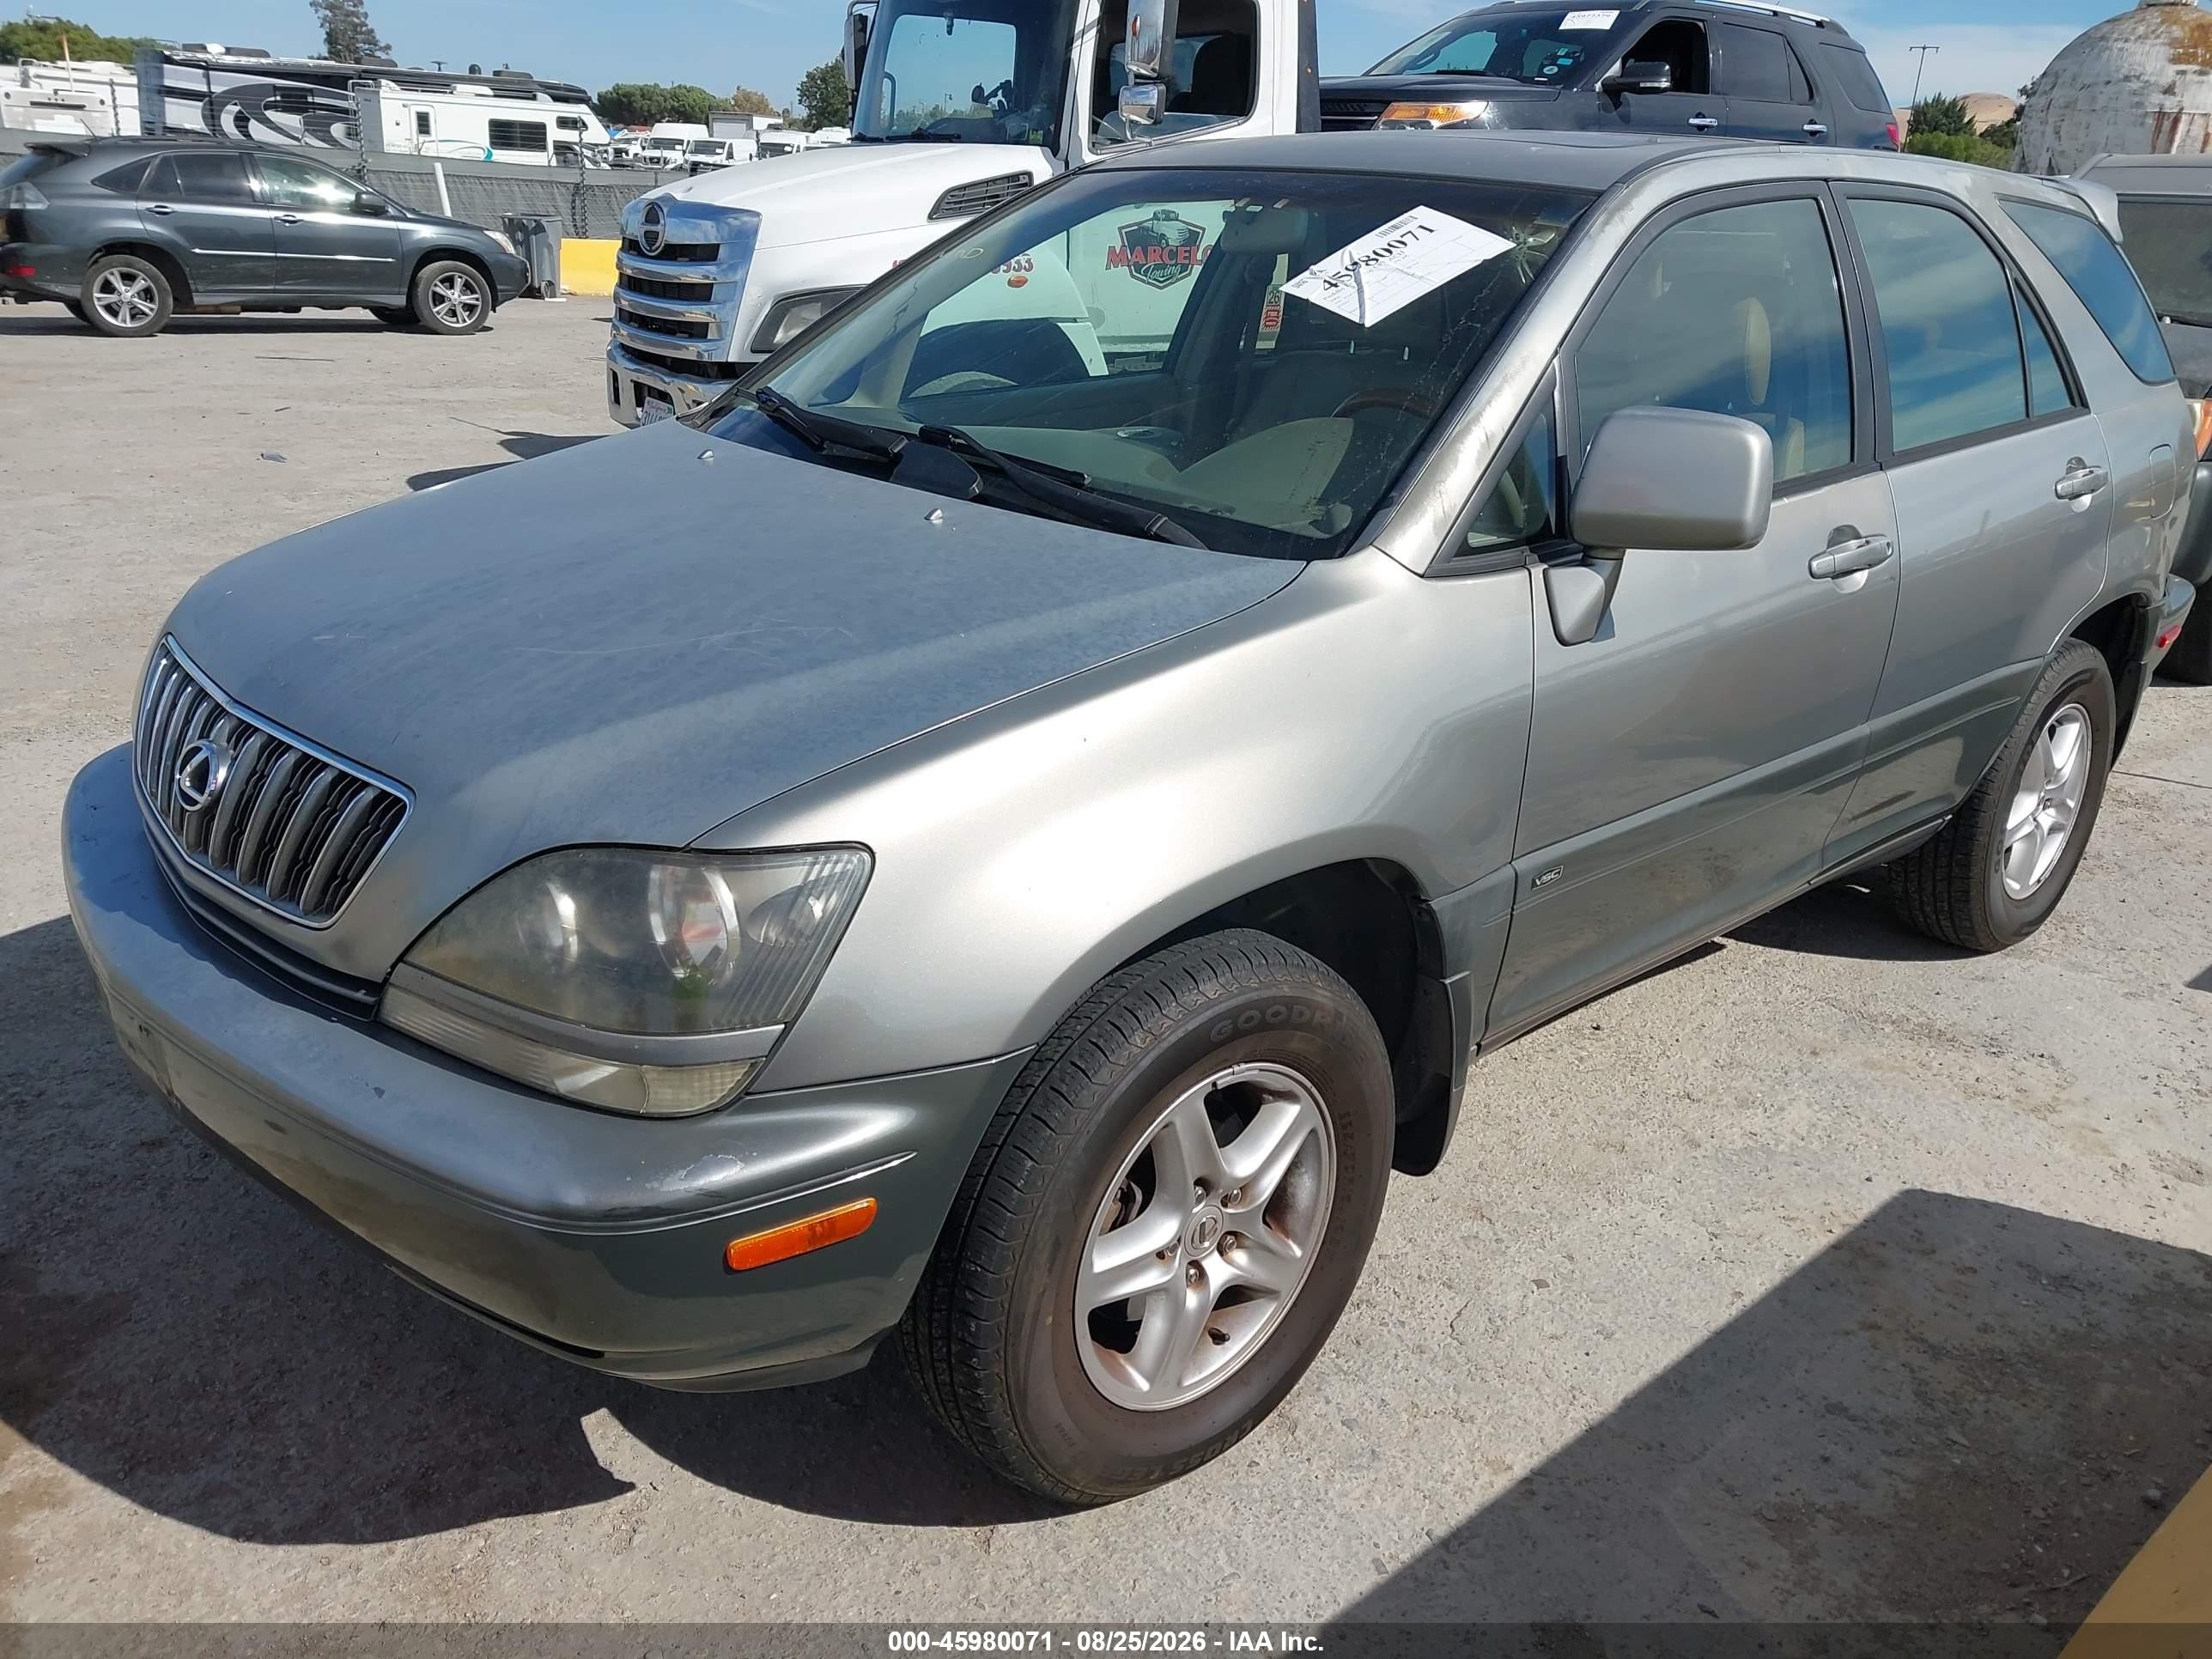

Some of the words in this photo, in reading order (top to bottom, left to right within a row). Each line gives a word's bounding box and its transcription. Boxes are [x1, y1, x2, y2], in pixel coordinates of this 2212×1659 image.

[1141, 262, 1182, 283] Towing
[1268, 290, 1279, 304] 26
[1534, 868, 1560, 885] VSC
